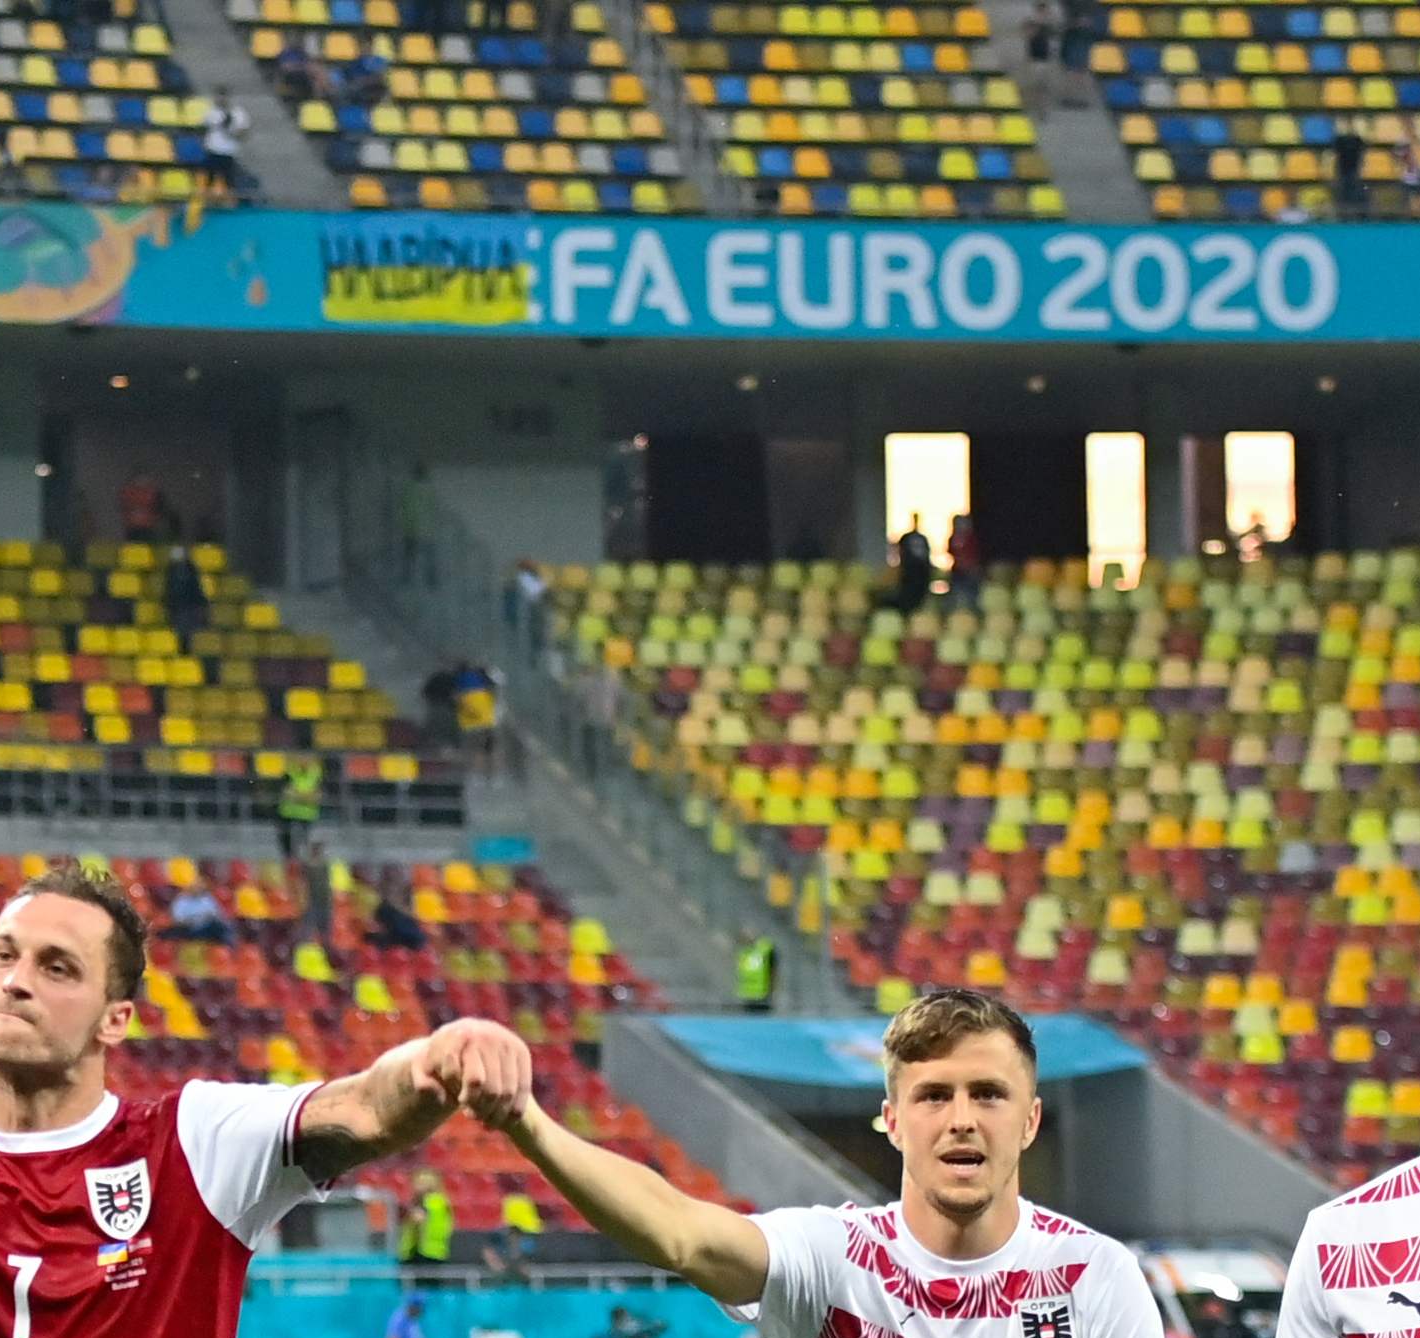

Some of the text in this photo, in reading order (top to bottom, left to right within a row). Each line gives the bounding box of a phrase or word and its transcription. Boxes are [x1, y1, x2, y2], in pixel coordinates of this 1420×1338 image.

[528, 227, 1339, 333] FA EURO 2020
